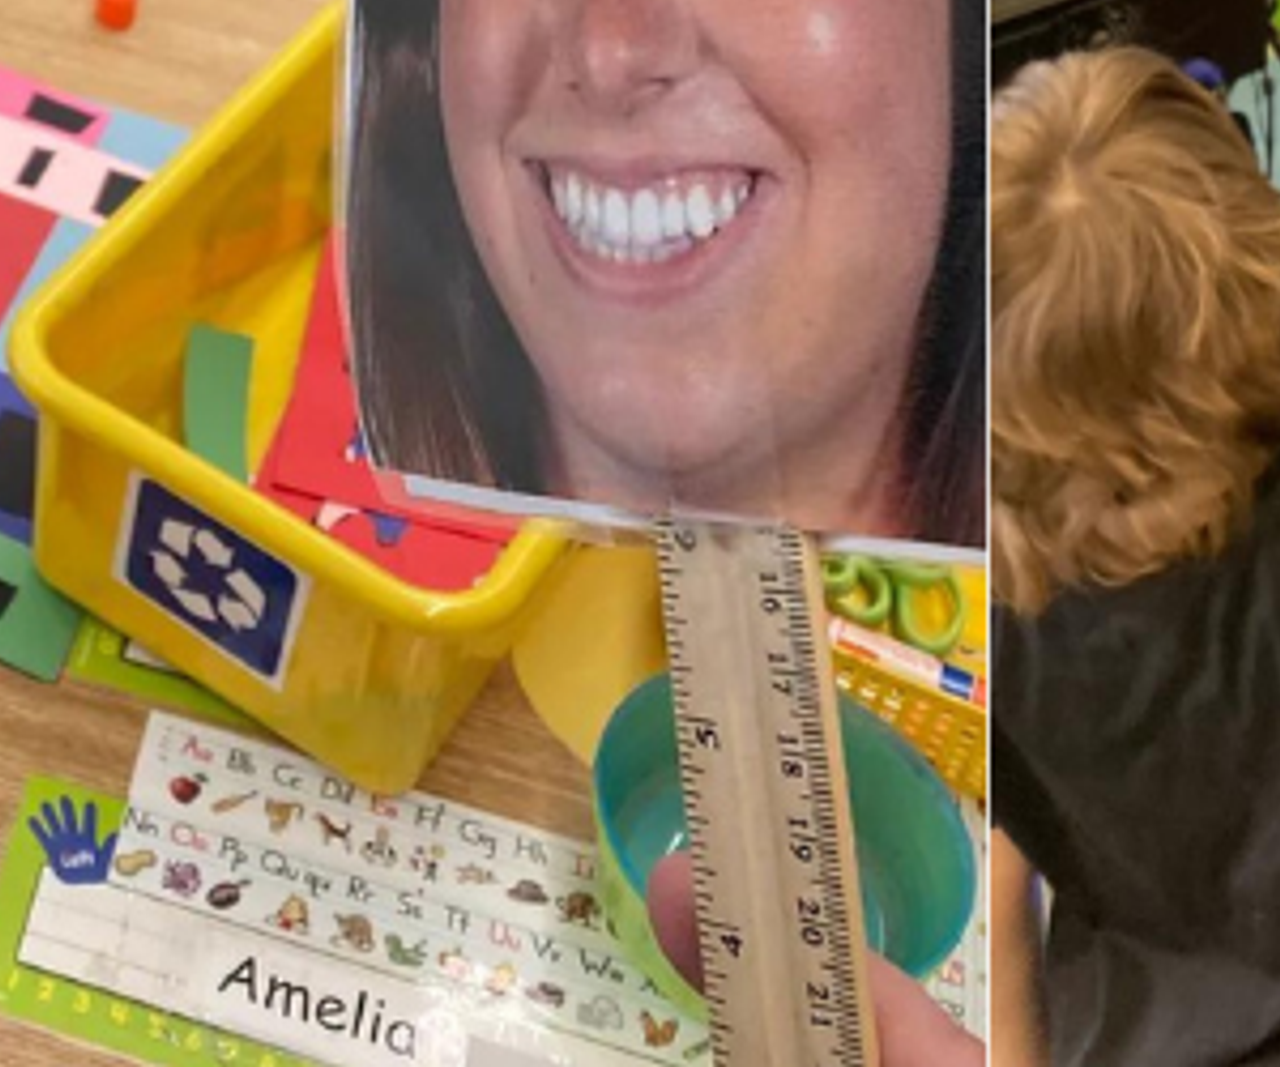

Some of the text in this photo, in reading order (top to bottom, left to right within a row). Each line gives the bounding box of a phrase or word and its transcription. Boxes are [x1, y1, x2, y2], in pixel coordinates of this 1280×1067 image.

[695, 725, 721, 751] 5
[720, 933, 743, 958] 4
[217, 955, 416, 1059] Amelia
